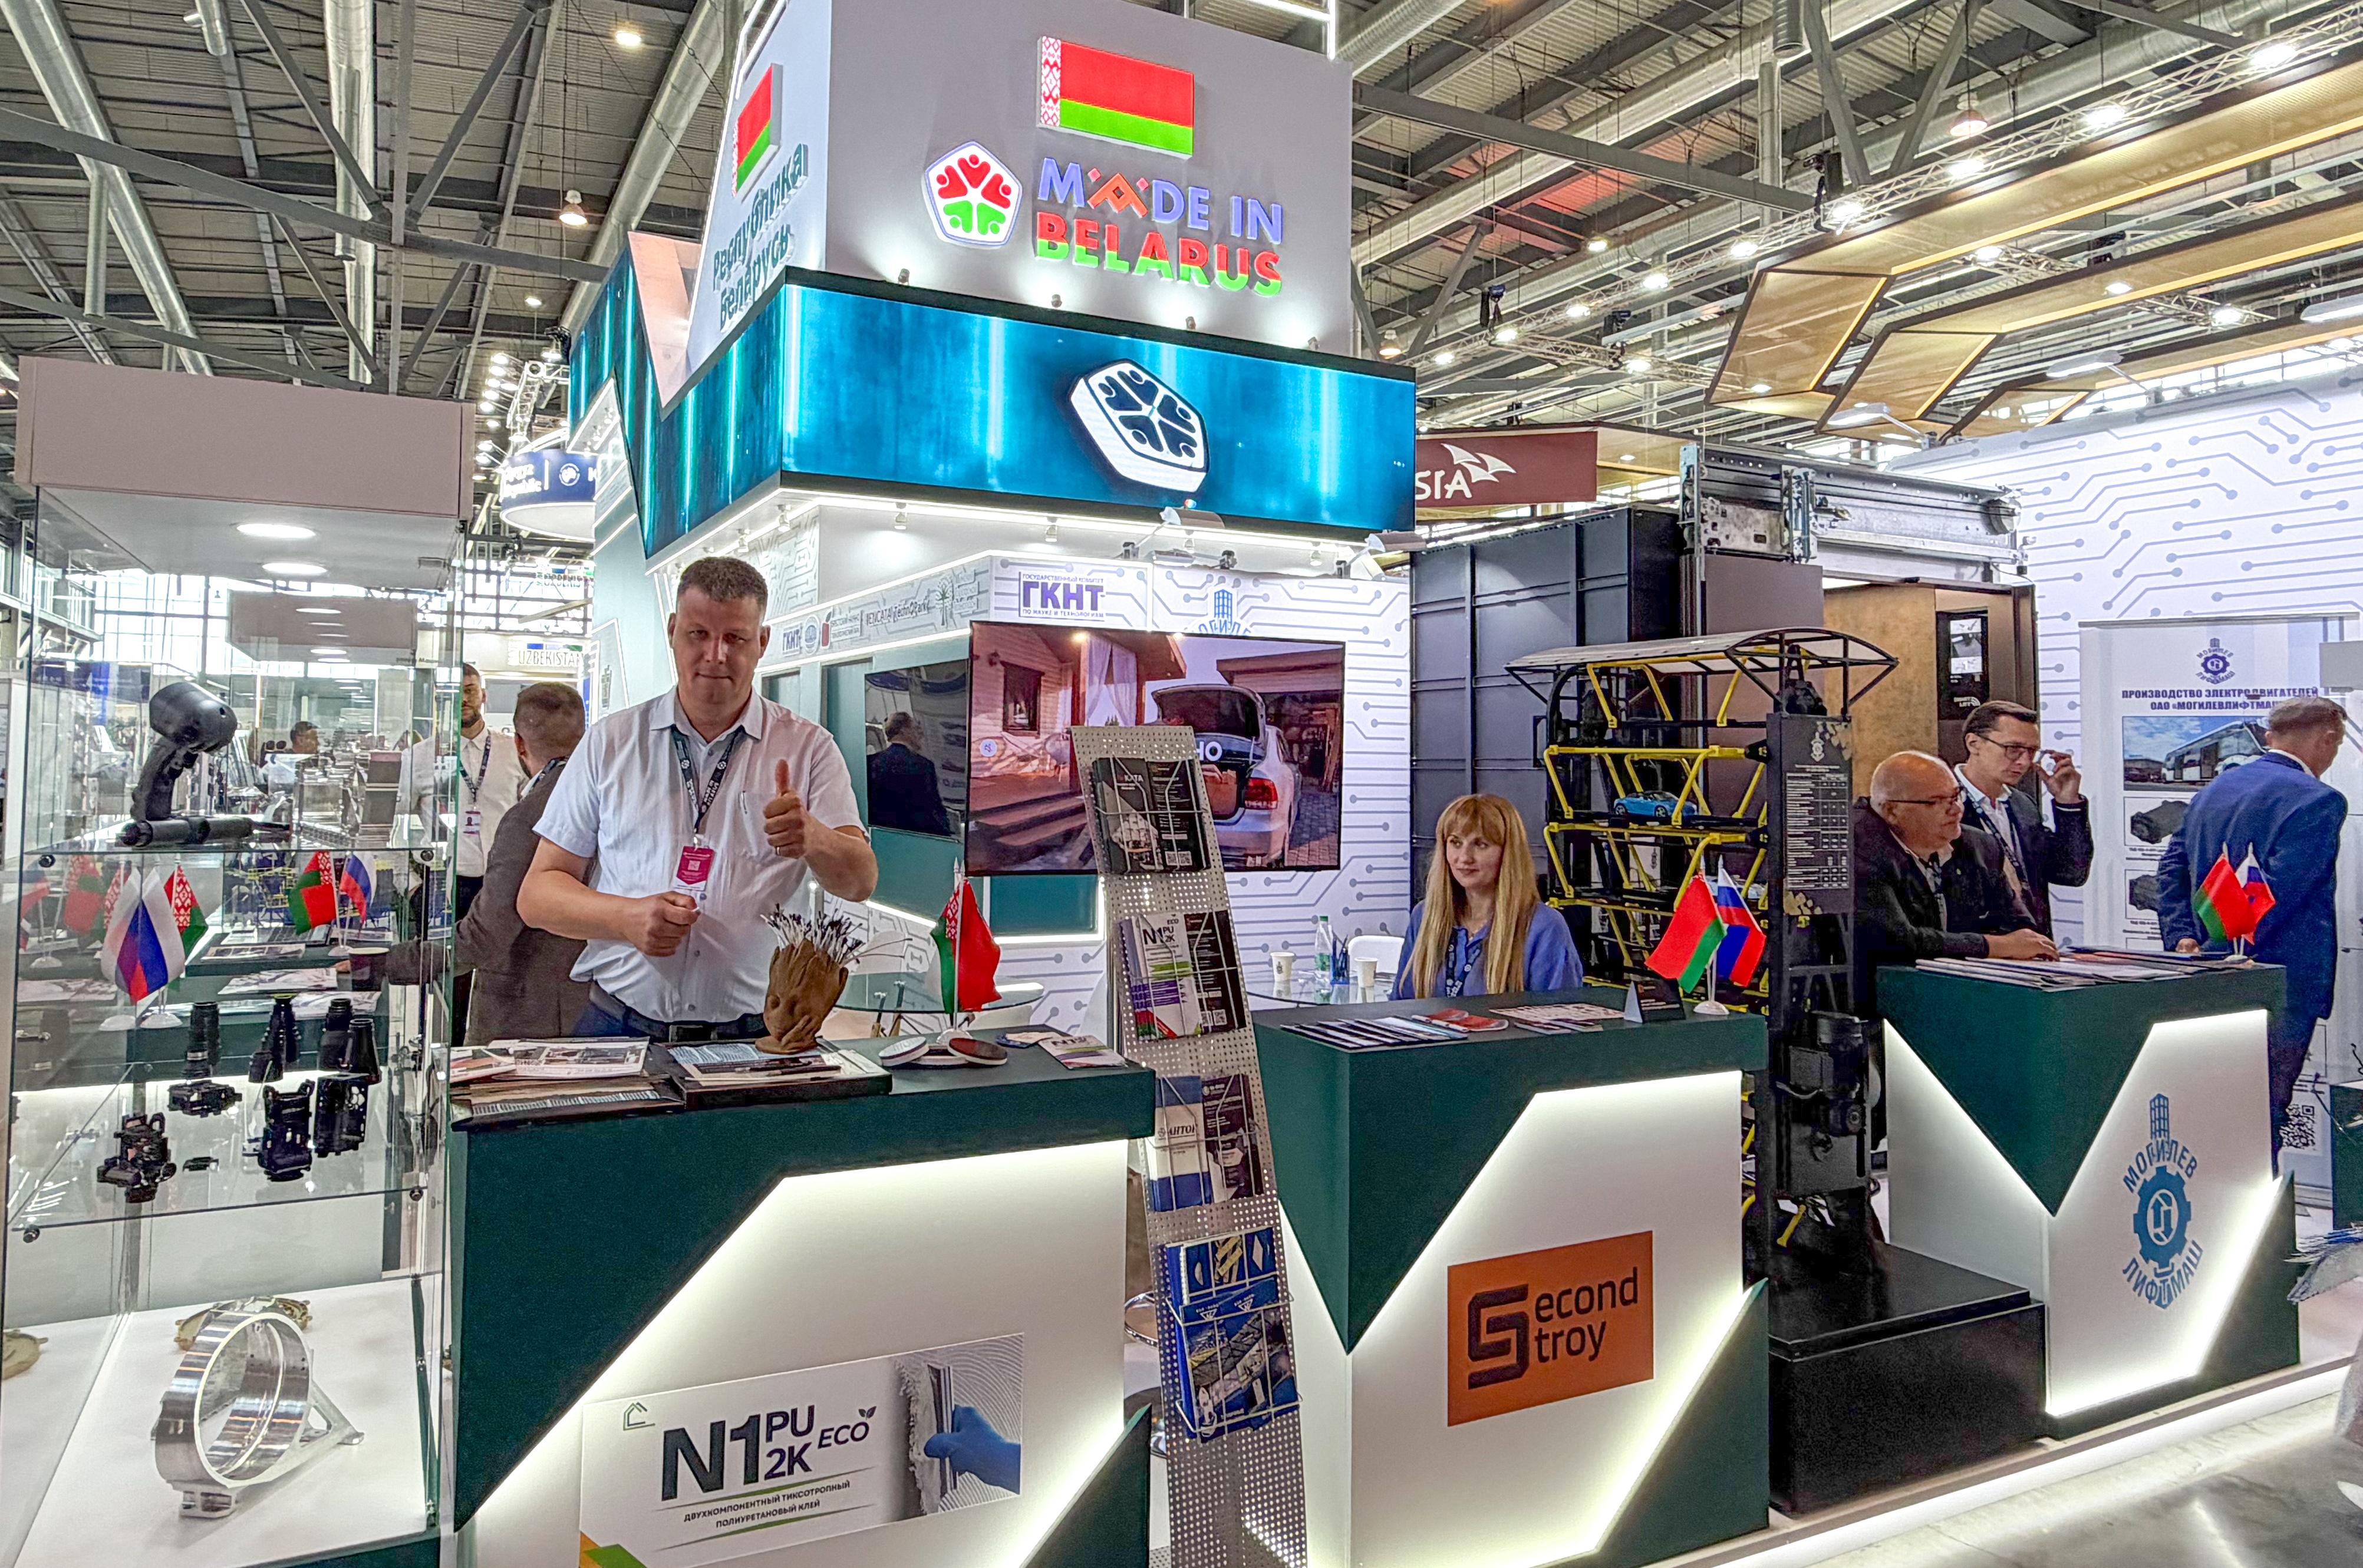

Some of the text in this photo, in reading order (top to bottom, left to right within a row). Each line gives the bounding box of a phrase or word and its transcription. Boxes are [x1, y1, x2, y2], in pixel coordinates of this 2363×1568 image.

[1037, 157, 1283, 245] MADE IN
[1036, 212, 1283, 298] BELARUS
[1023, 580, 1103, 611] ГКНТ
[2122, 689, 2203, 699] ПРОИЗВОДСТВО
[2151, 701, 2170, 710] ОАО
[2123, 1139, 2197, 1193] МОГИЛЕВ
[2123, 1239, 2203, 1306] ЛИФТМАШ
[766, 1405, 815, 1442] PU
[818, 1421, 870, 1449] ECO
[661, 1414, 761, 1502] N1
[764, 1442, 812, 1481] 2K
[684, 1480, 851, 1523] ДВУХКОМПОНЕНТНЫЙ ТИКСОТРОПНЫЙ
[716, 1499, 820, 1529] ПОЛИУРЕТАНОВЫЙ КЛЕЙ
